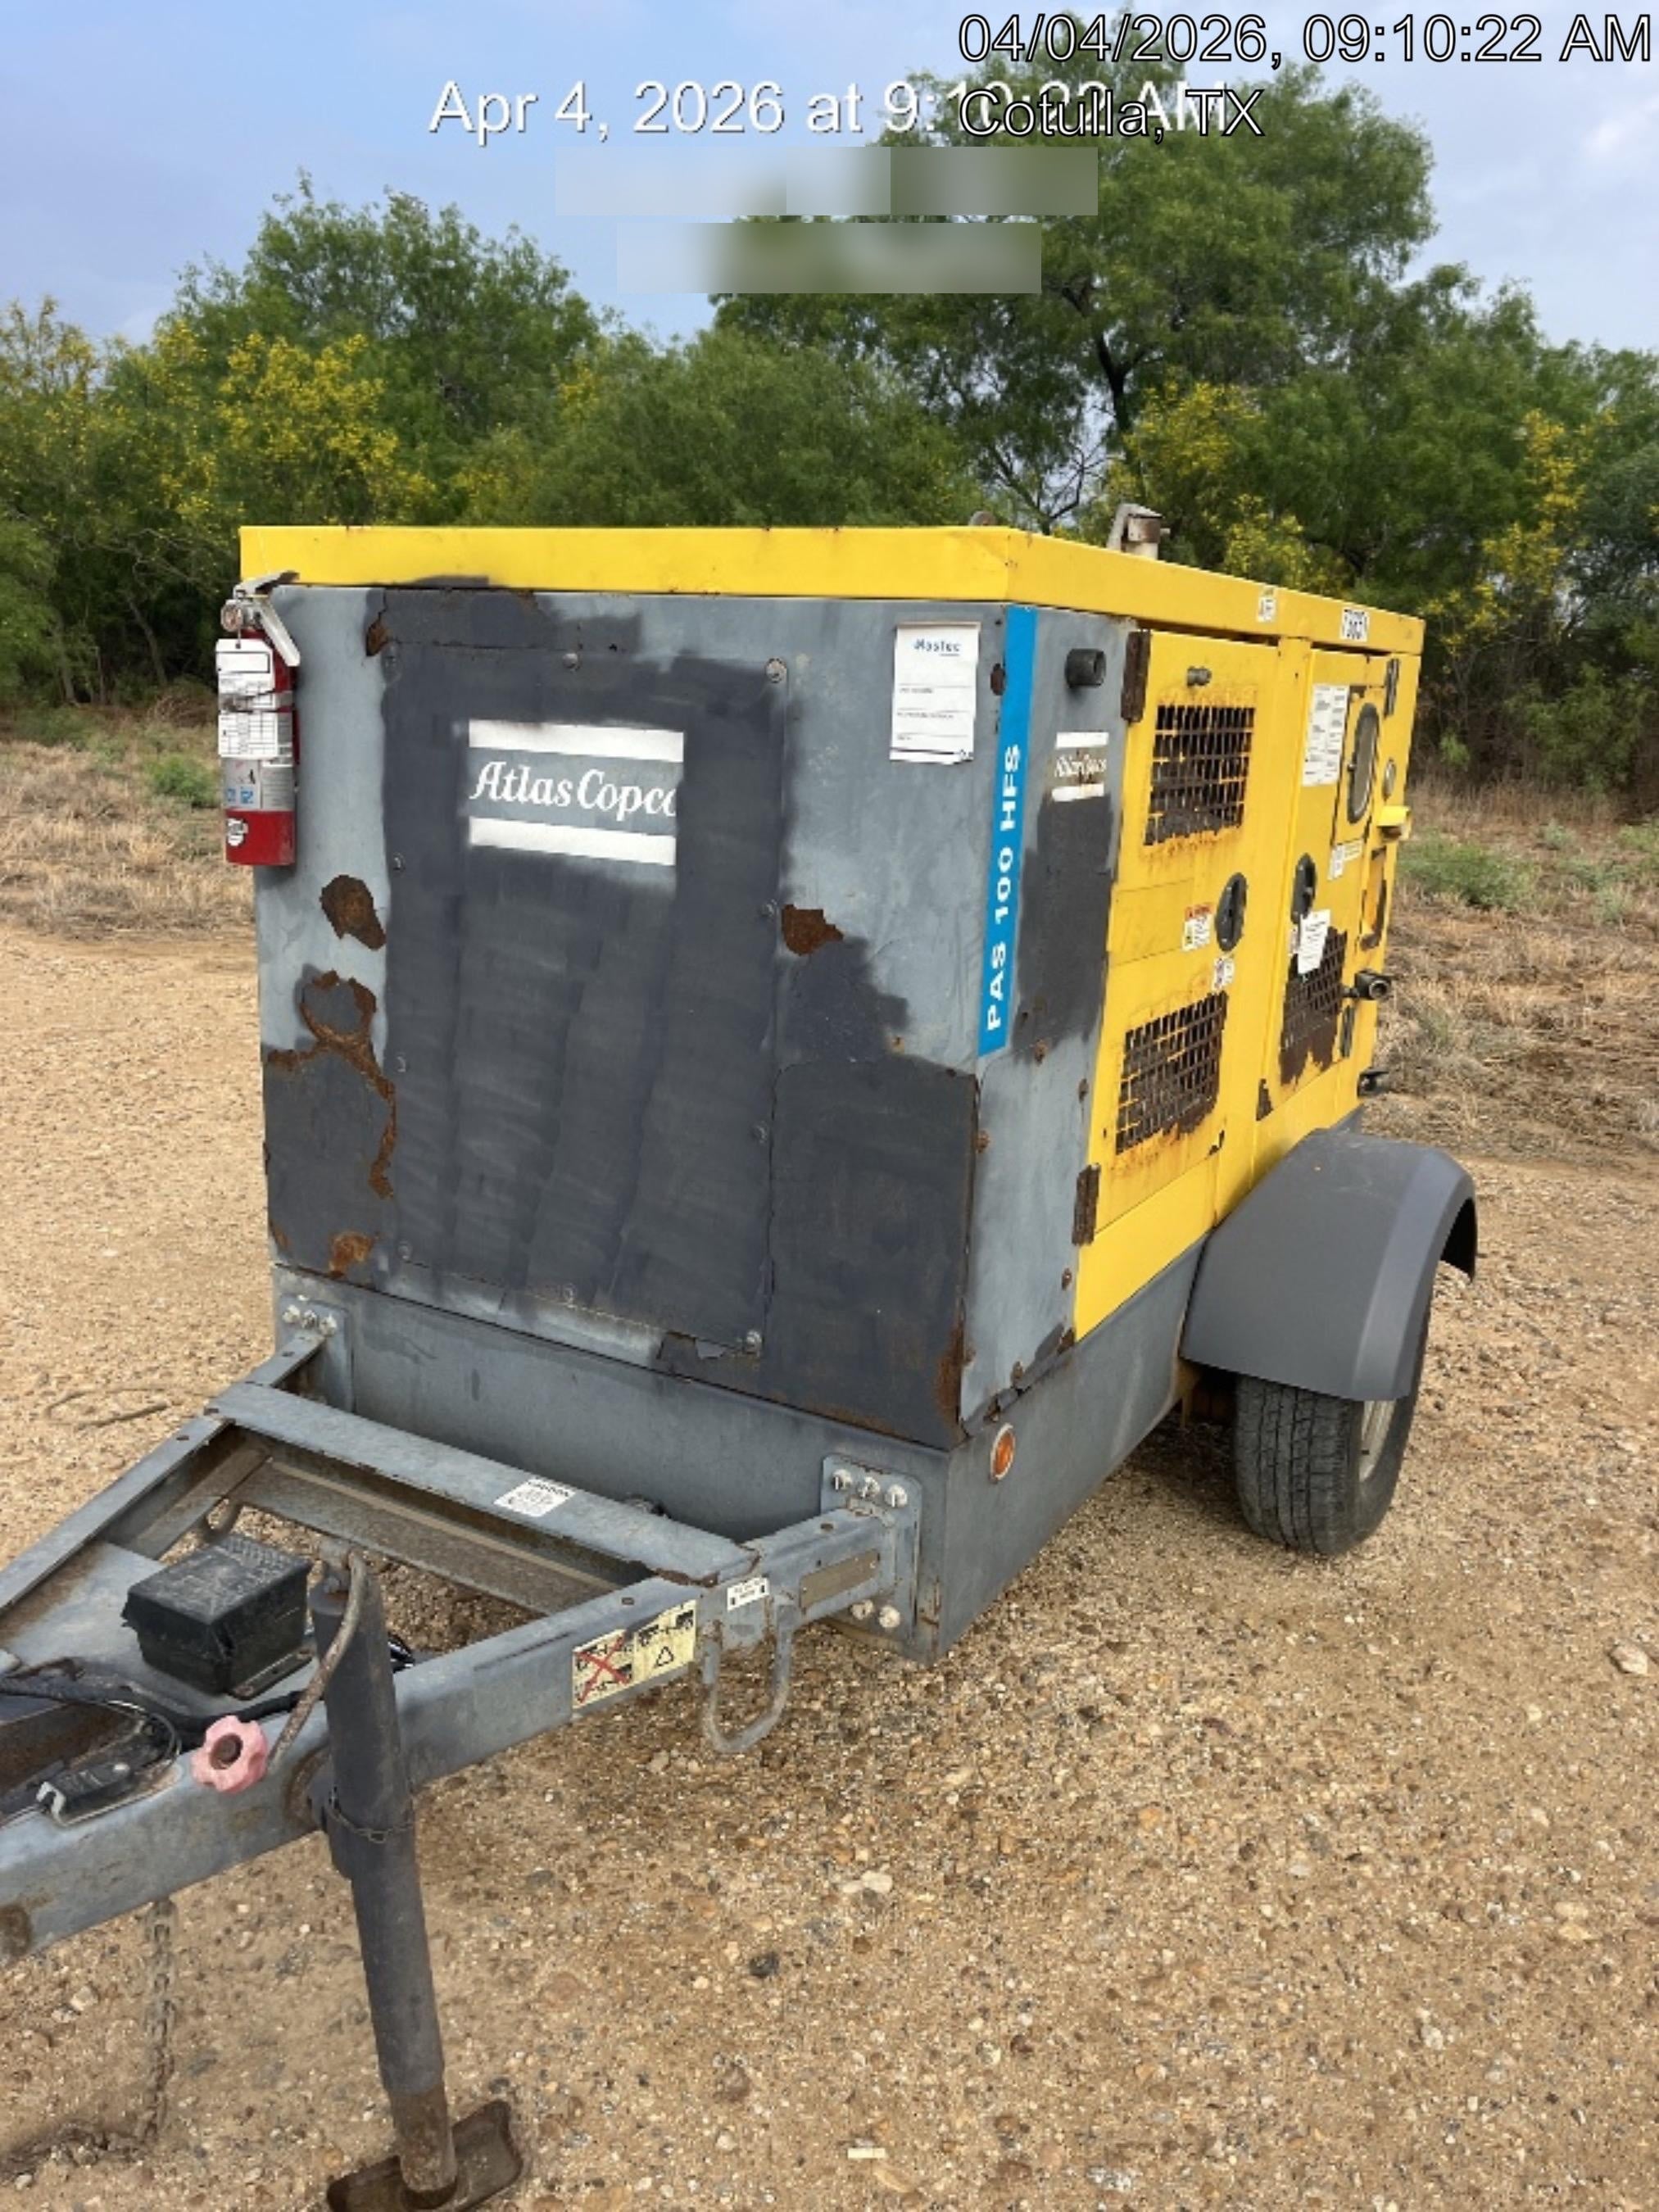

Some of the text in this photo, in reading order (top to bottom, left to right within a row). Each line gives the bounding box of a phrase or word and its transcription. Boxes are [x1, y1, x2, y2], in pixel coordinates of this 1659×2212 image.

[468, 760, 573, 808] Atlas
[986, 744, 1021, 1031] PAS 100 HFS
